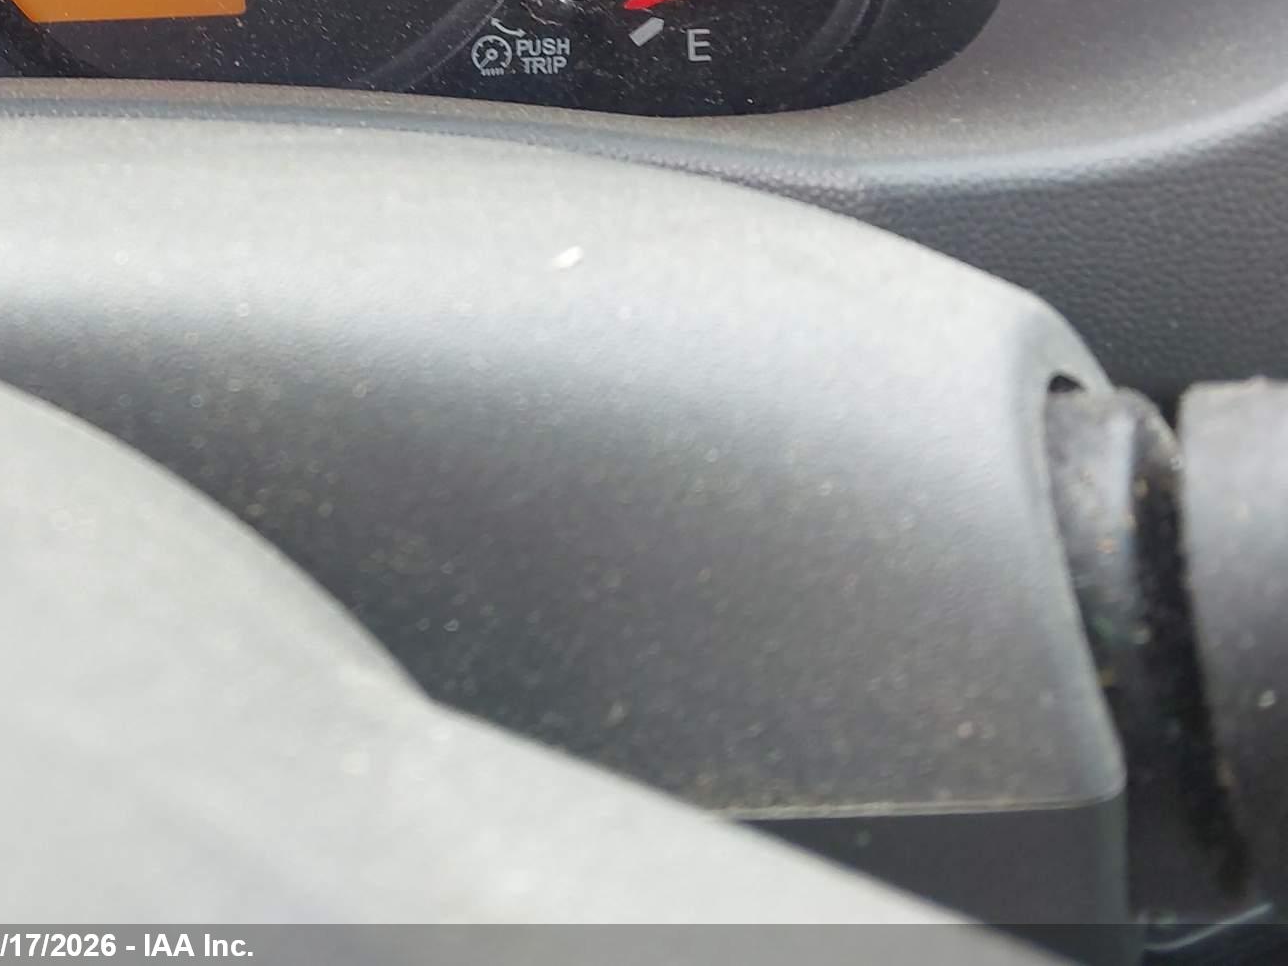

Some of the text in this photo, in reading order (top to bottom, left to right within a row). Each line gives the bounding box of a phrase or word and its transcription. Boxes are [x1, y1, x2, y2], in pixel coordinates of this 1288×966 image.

[516, 37, 570, 57] PUSH
[687, 28, 711, 62] E
[521, 56, 567, 75] TRIP
